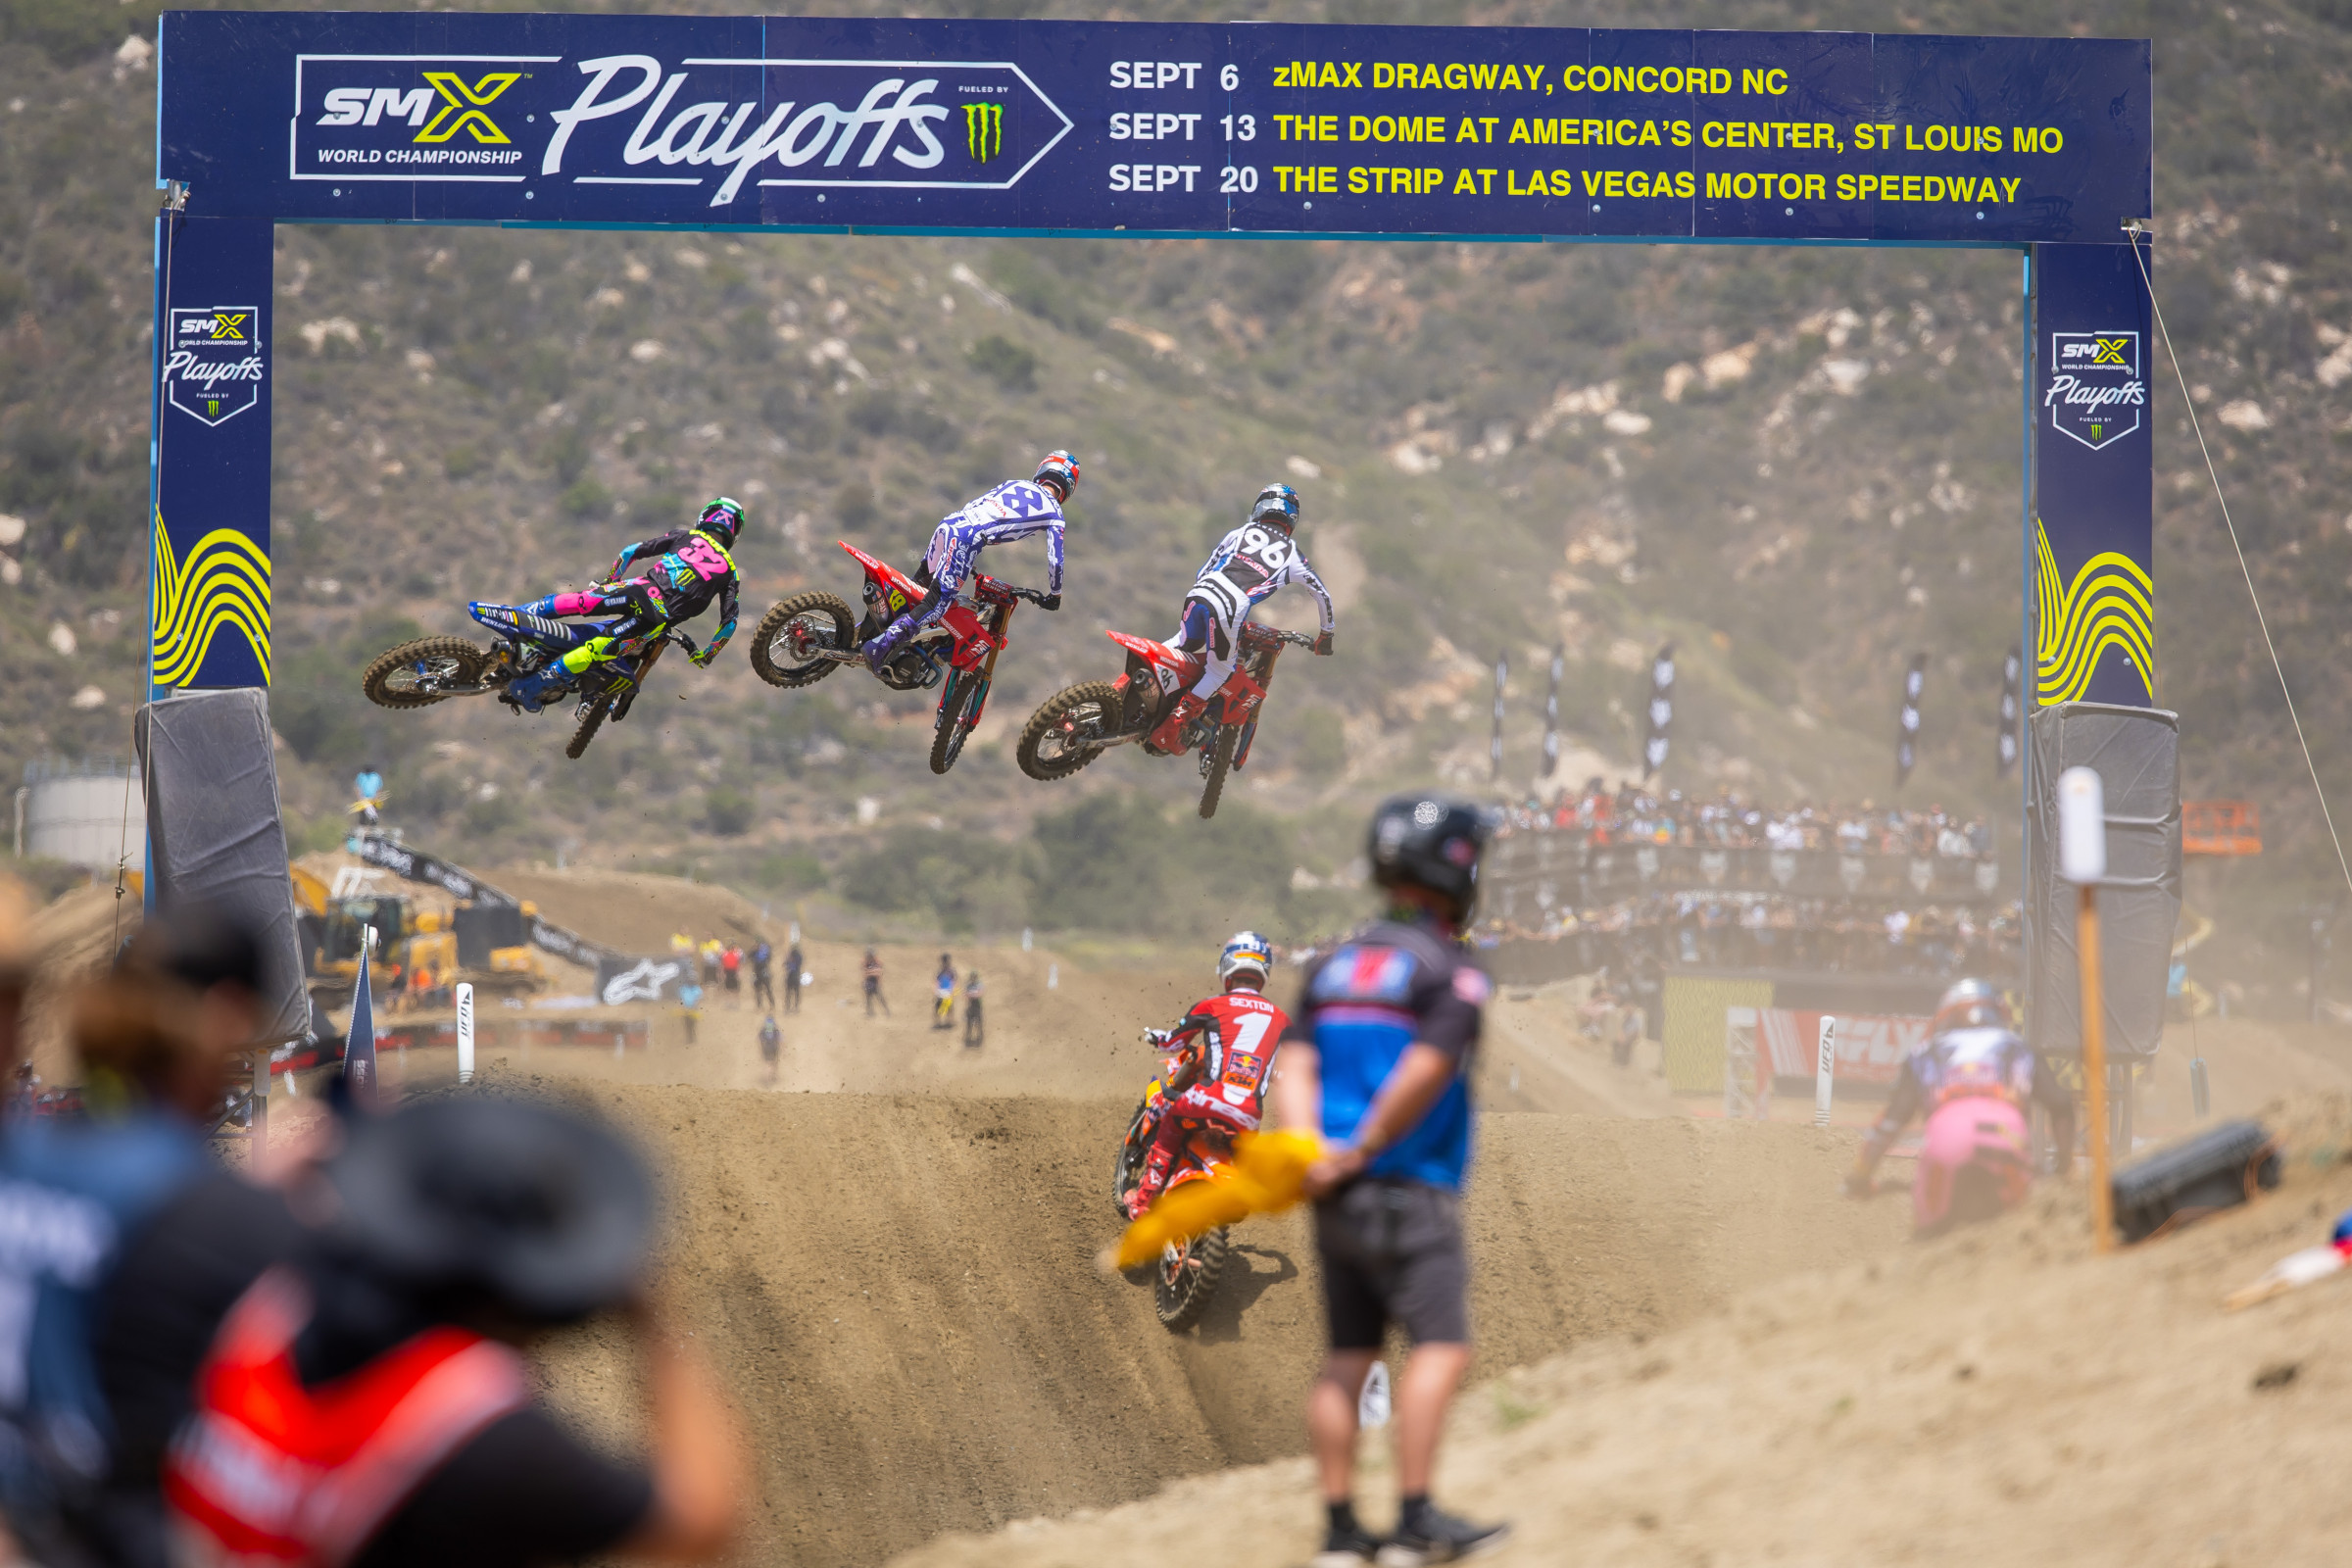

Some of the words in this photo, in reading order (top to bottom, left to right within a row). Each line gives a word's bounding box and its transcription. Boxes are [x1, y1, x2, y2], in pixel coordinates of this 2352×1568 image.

[1109, 62, 1202, 89] SEPT
[1220, 64, 1240, 92] 6
[1273, 61, 1363, 88] zMAX
[1373, 62, 1553, 96] DRAGWAY,
[1563, 65, 1733, 94] CONCORD
[1742, 68, 1788, 95] NC
[316, 72, 522, 144] SMX
[541, 54, 950, 207] Playoffs
[1108, 113, 1202, 141] SEPT
[1220, 115, 1256, 141] 13
[1273, 114, 1339, 141] THE
[1348, 115, 1446, 143] DOME
[1455, 117, 1500, 144] AT
[1701, 121, 1844, 155] CENTER,
[1854, 122, 1896, 150] ST
[1905, 124, 2003, 153] LOUIS
[2013, 126, 2064, 154] MO
[318, 149, 382, 163] WORLD
[385, 150, 522, 165] CHAMPIONSHIP
[1108, 164, 1201, 193] SEPT
[1219, 166, 1258, 194] 20
[1272, 166, 1338, 193] THE
[1348, 166, 1445, 194] STRIP
[1452, 168, 1498, 195] AT
[1507, 169, 1572, 197] LAS
[1581, 170, 1696, 199] VEGAS
[1706, 172, 1827, 200] MOTOR
[1836, 173, 2022, 203] SPEEDWAY
[178, 314, 247, 338] SMX
[2061, 338, 2129, 364] SMX
[161, 351, 264, 391] Playoffs
[2044, 374, 2145, 415] Playoffs
[677, 536, 729, 582] 32
[1240, 527, 1288, 569] 96
[889, 589, 907, 612] 18
[891, 576, 912, 594] HONDA
[480, 616, 508, 630] DUNLOP
[1159, 656, 1180, 668] HONDA
[1228, 996, 1275, 1014] SEXTON
[1230, 1010, 1274, 1054] 1
[1821, 1038, 1833, 1074] UFO
